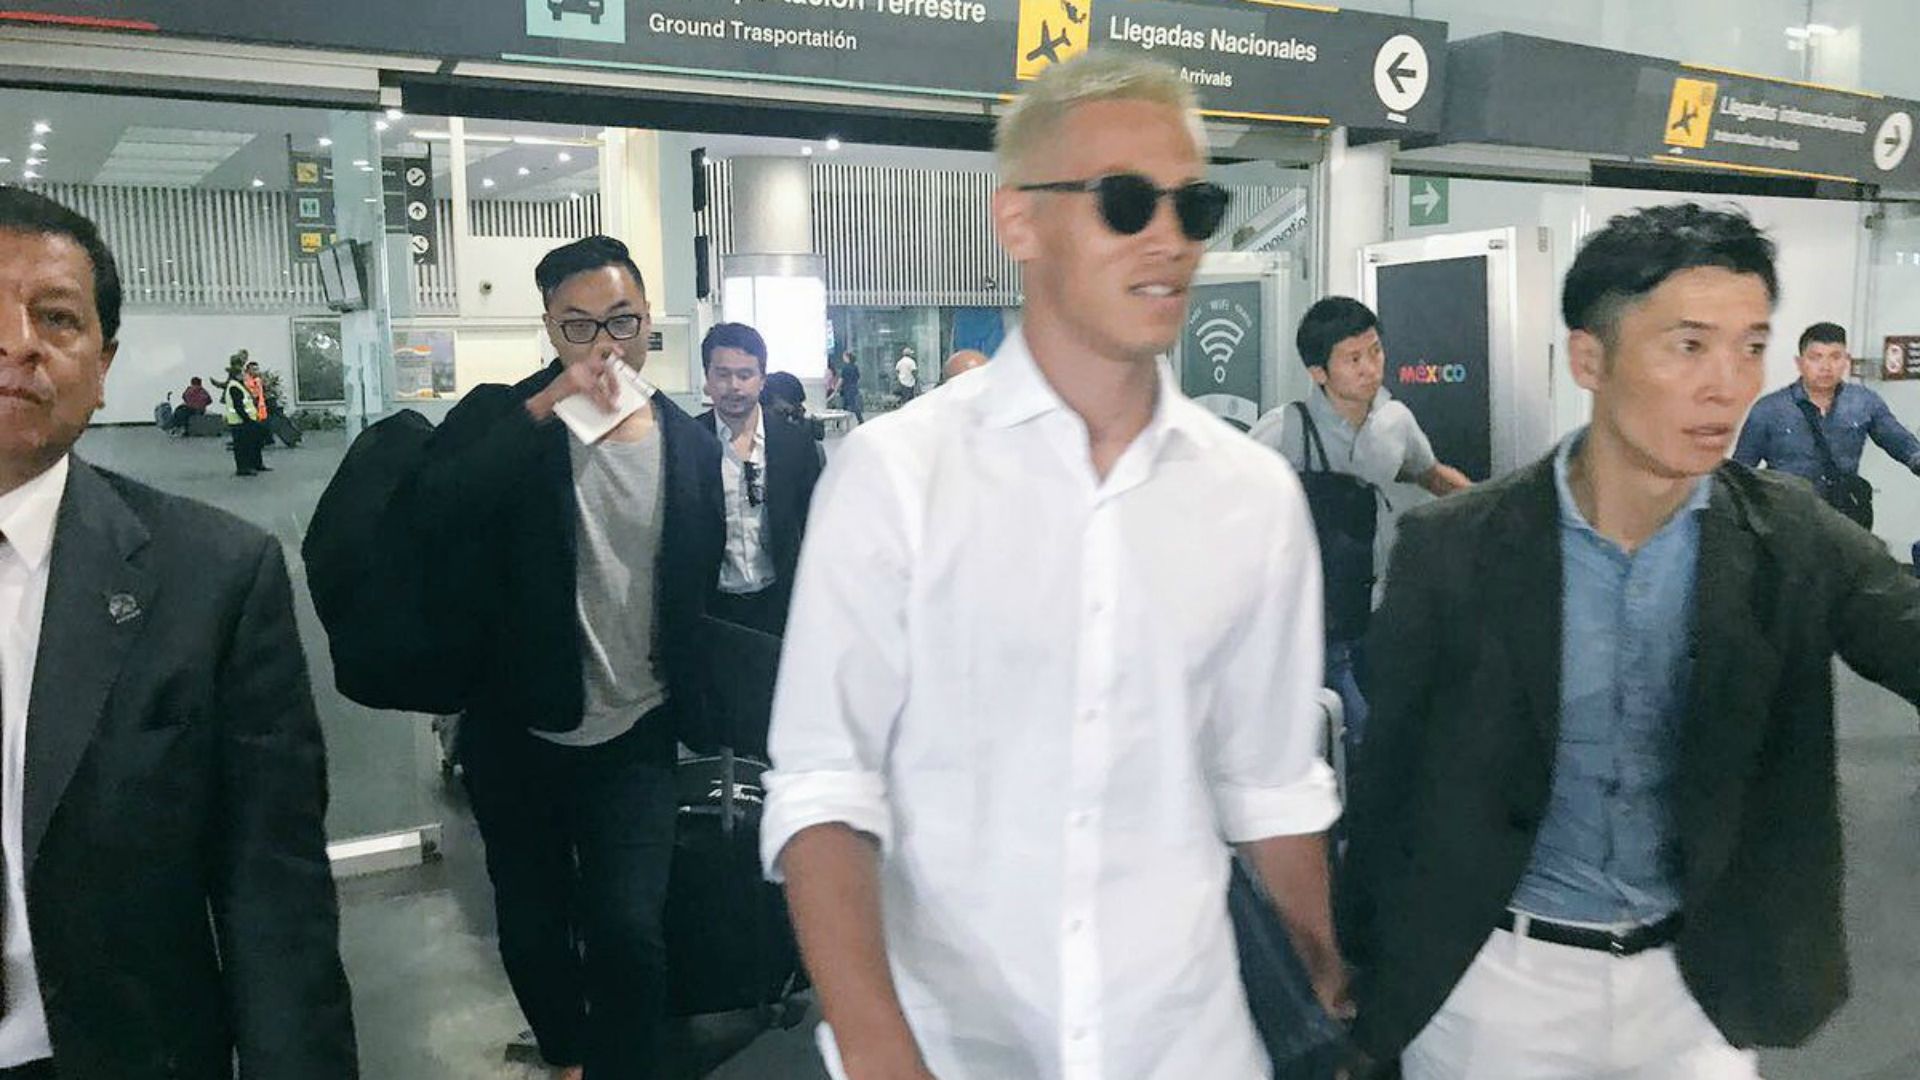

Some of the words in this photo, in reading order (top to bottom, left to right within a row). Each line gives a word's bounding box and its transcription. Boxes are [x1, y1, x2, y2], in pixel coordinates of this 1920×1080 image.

[649, 13, 725, 38] Ground
[731, 20, 857, 50] Trasportatión
[1110, 15, 1205, 49] Llegadas
[1210, 28, 1318, 62] Nacionales
[1180, 66, 1233, 87] Arrivals
